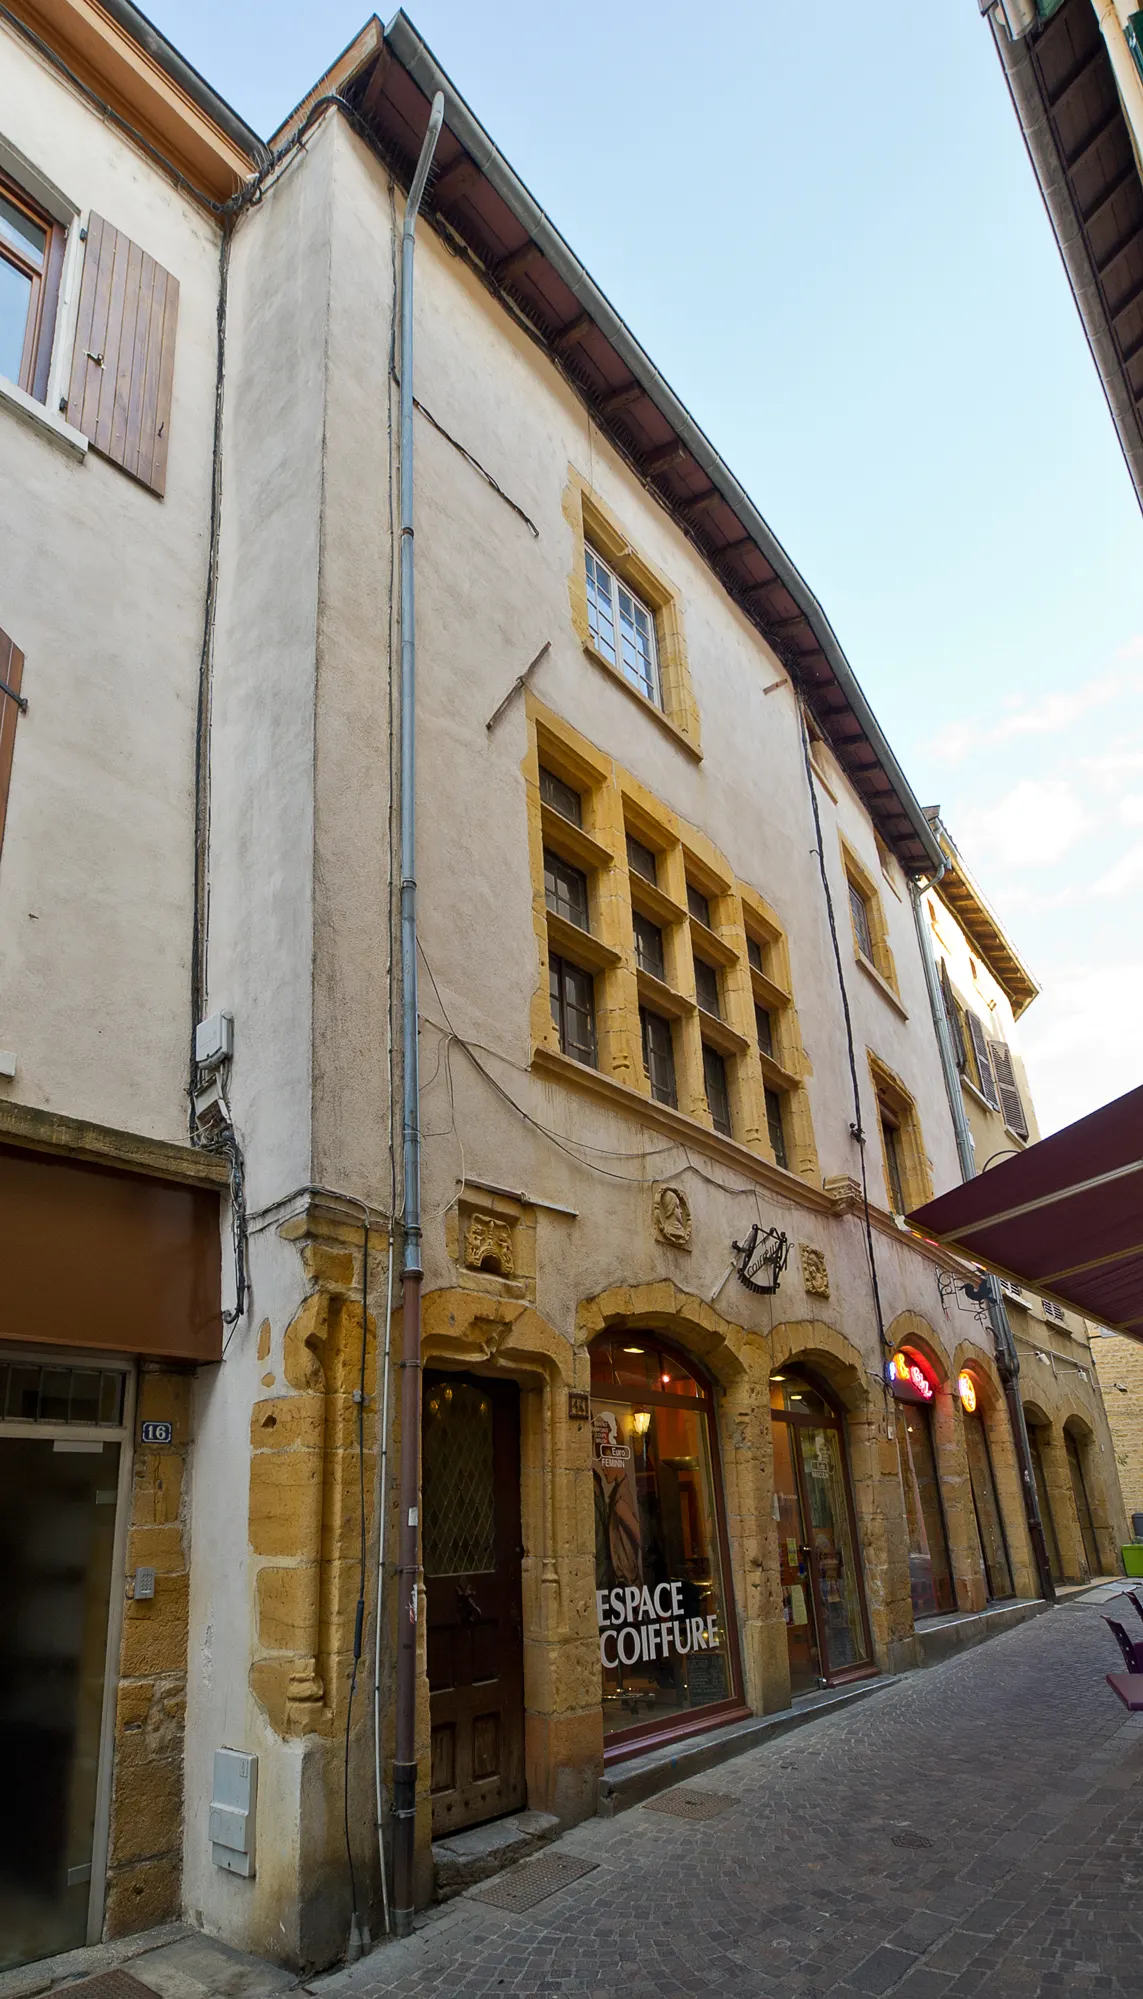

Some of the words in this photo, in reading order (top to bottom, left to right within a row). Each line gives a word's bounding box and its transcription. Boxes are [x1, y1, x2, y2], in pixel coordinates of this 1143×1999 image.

[148, 1425, 166, 1439] 16
[611, 1447, 626, 1457] Euro
[595, 1582, 685, 1626] ESPACE
[600, 1614, 720, 1668] COIFFURE
